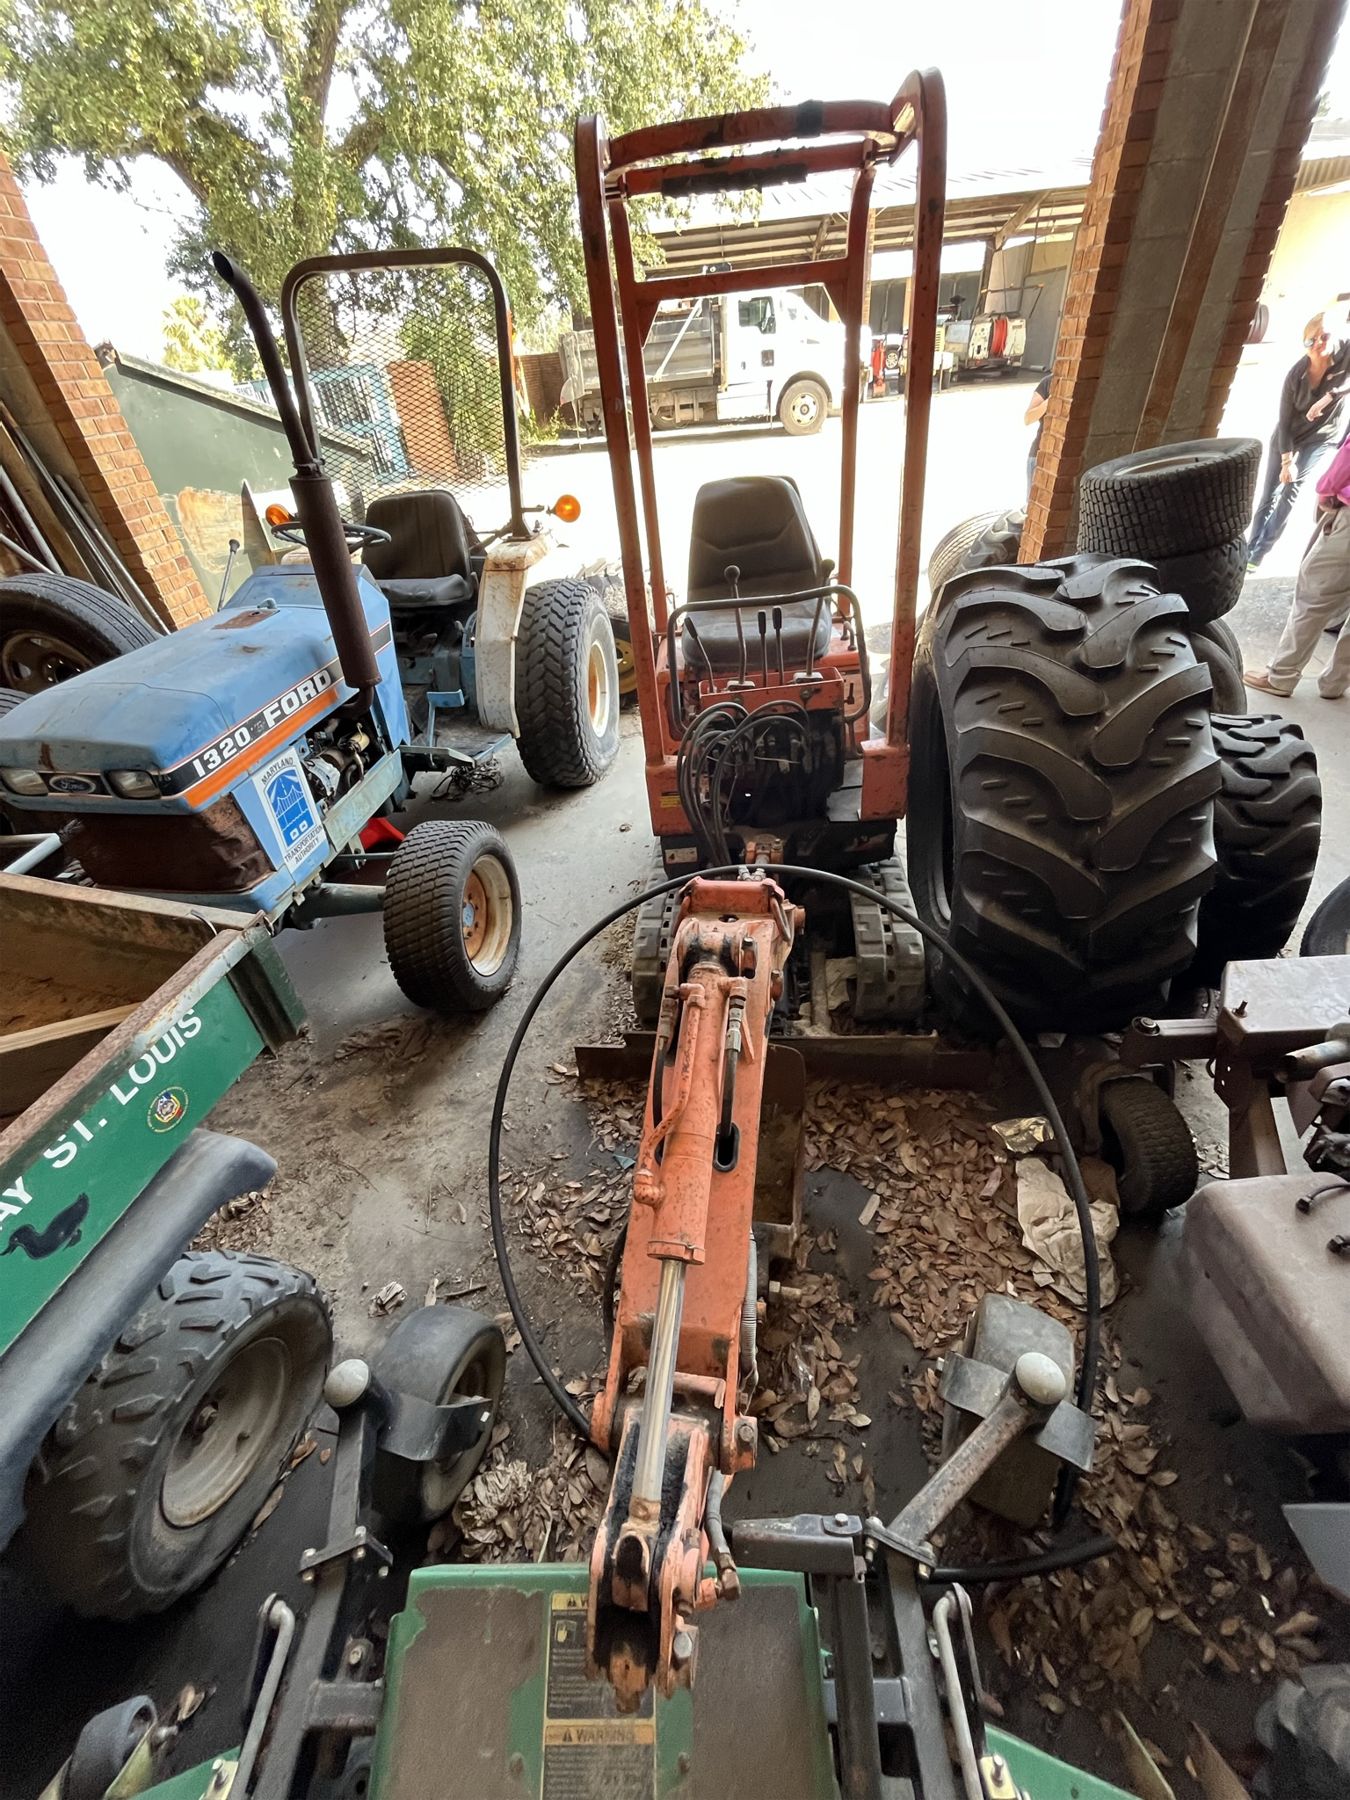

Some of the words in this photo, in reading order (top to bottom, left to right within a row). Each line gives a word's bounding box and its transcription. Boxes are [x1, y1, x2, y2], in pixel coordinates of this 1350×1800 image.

[193, 726, 251, 777] 1320
[263, 669, 332, 728] FORD
[261, 757, 294, 785] MARYLAND
[284, 825, 323, 863] TRANSPORTATION
[294, 837, 320, 865] AUTHORITY
[109, 1008, 202, 1106] LOUIS
